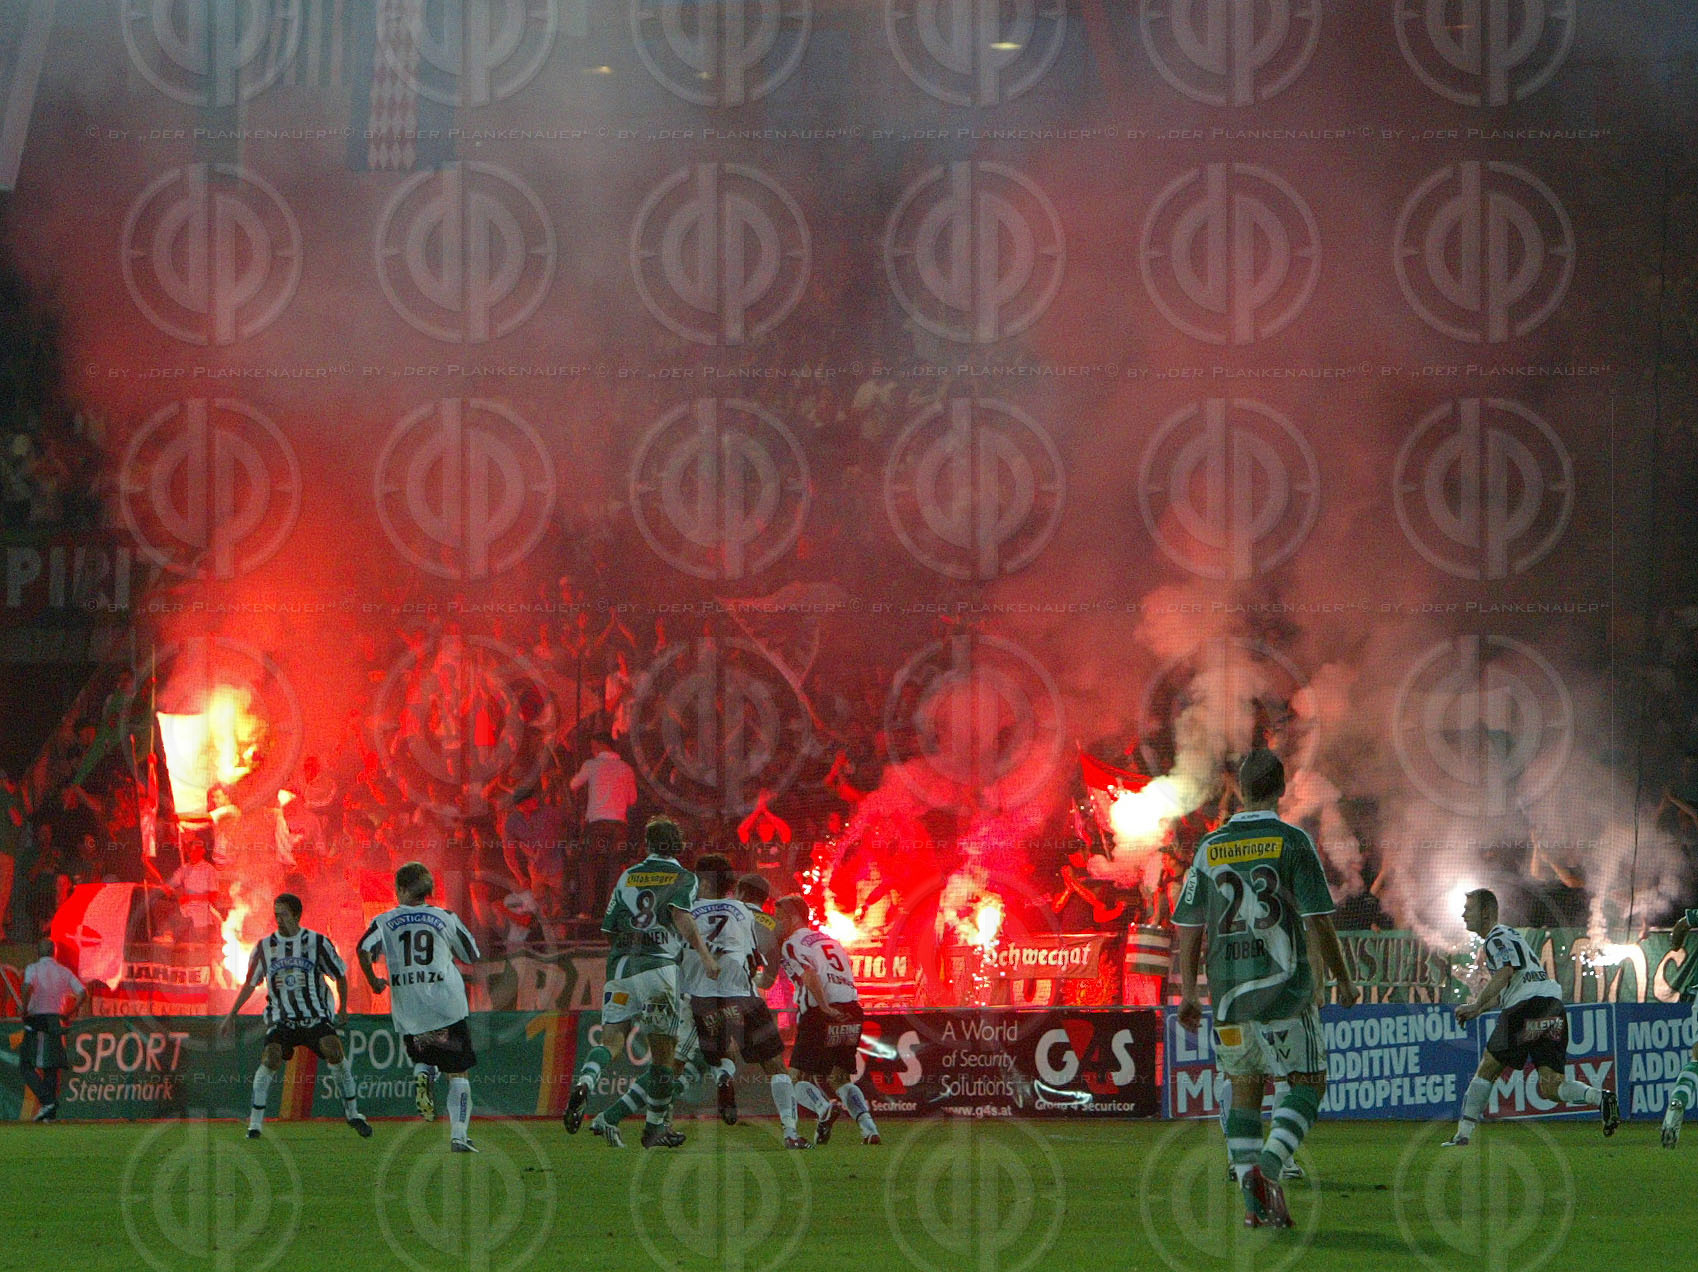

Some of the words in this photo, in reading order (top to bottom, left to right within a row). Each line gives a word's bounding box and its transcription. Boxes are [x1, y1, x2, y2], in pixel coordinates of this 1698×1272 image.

[1214, 864, 1284, 936] 23
[387, 913, 445, 931] PUNTIGAMER
[706, 914, 739, 942] 7
[398, 930, 435, 967] 19
[821, 944, 845, 972] 5
[943, 1021, 957, 1041] A
[962, 1020, 1018, 1042] World
[72, 1031, 190, 1074] SPORT
[942, 1049, 957, 1067] of
[959, 1049, 1017, 1073] Security
[1327, 1046, 1420, 1081] DDITIVE
[66, 1076, 173, 1103] Steiermark
[940, 1074, 1013, 1097] Solutions
[1081, 1099, 1136, 1113] Securicor
